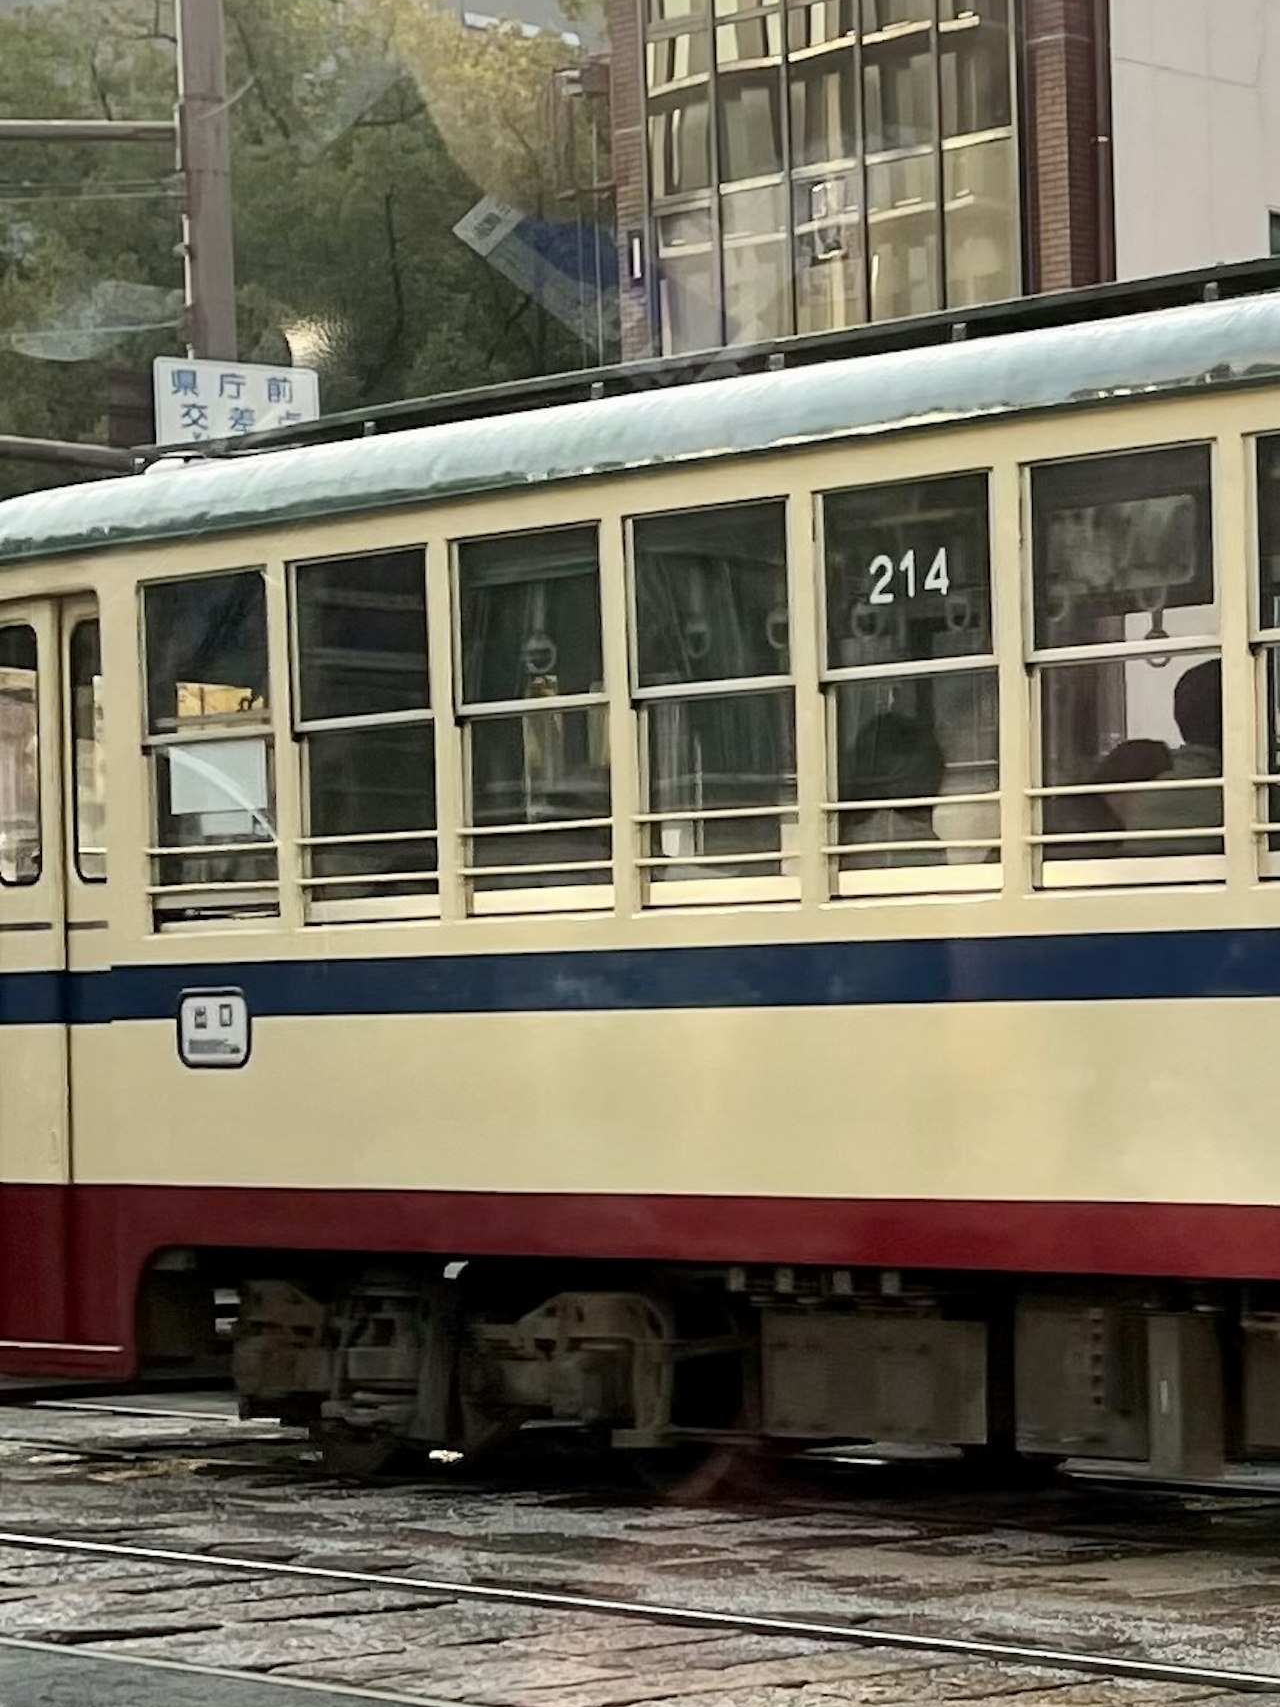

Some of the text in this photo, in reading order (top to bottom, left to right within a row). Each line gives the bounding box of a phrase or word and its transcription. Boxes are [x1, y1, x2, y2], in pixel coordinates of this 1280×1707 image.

[171, 369, 293, 404] 県庁前
[868, 546, 950, 605] 214
